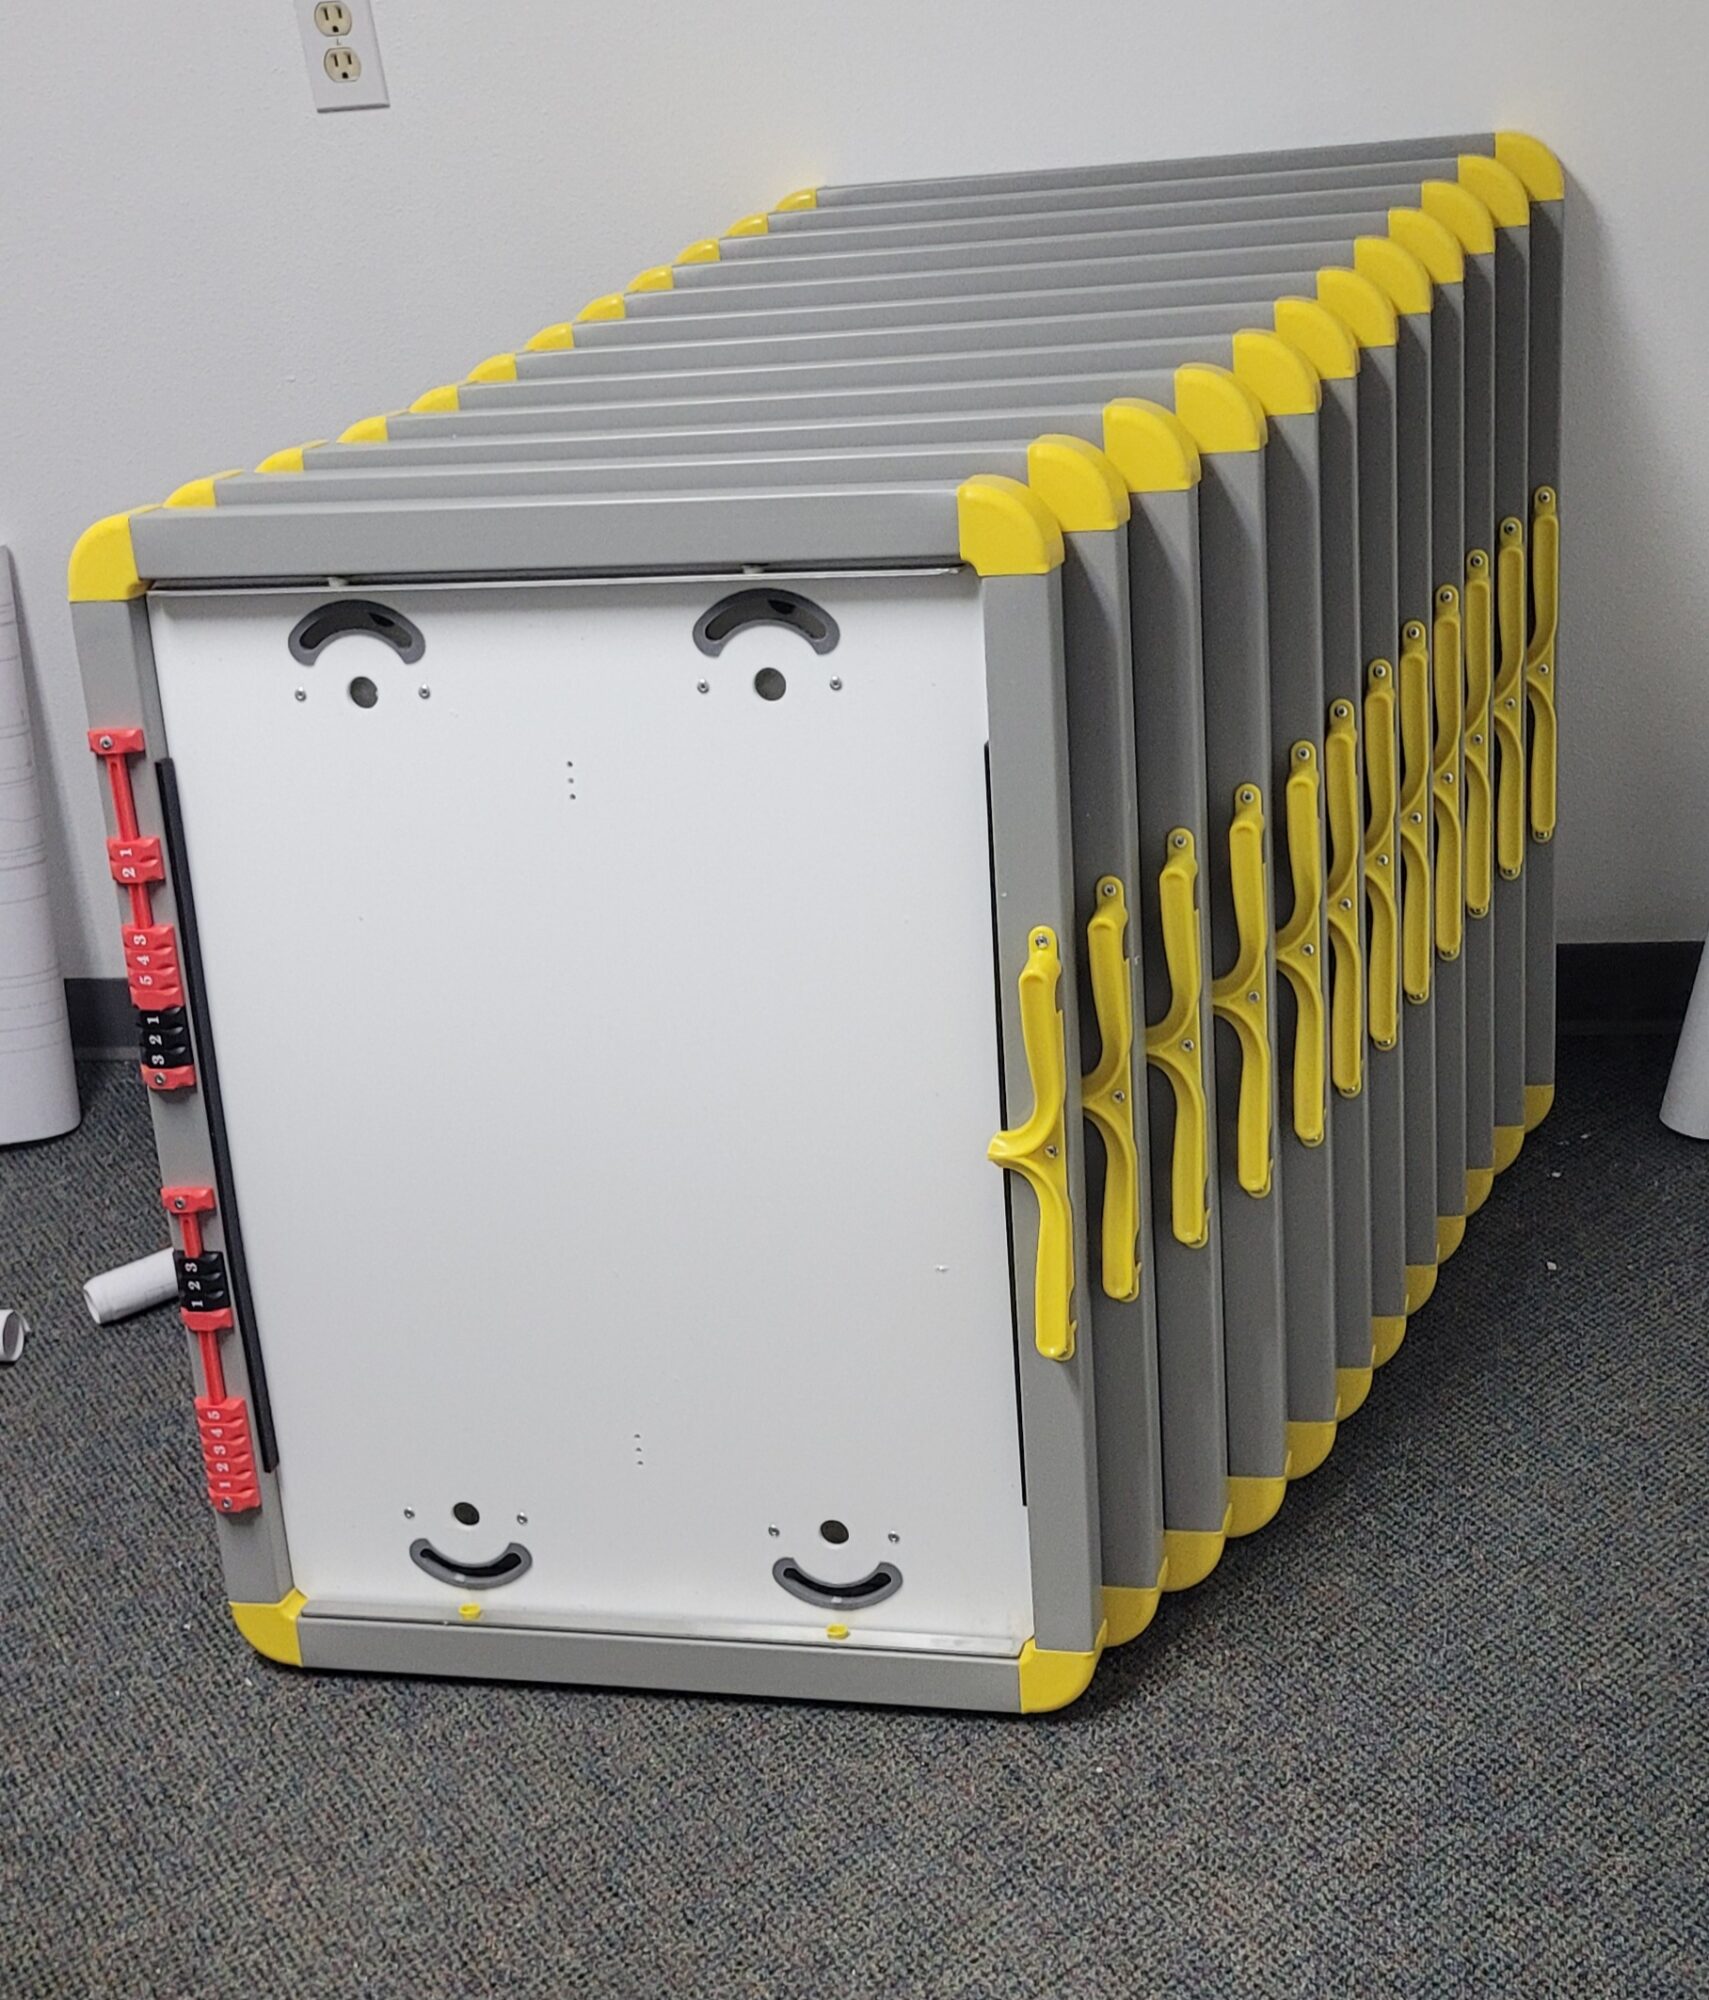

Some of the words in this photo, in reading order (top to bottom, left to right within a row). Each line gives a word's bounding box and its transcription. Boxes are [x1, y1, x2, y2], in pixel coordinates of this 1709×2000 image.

[119, 848, 133, 857] 1
[122, 867, 136, 878] 2
[133, 934, 147, 946] 3
[136, 954, 150, 966] 4
[139, 975, 153, 986] 5
[146, 1016, 160, 1025] 1
[148, 1034, 163, 1046] 2
[151, 1054, 165, 1065] 3
[184, 1262, 198, 1273] 3
[187, 1280, 201, 1291] 2
[191, 1300, 204, 1308] 1
[207, 1410, 220, 1420] 5
[210, 1428, 223, 1438] 4
[213, 1445, 226, 1455] 3
[215, 1462, 229, 1472] 2
